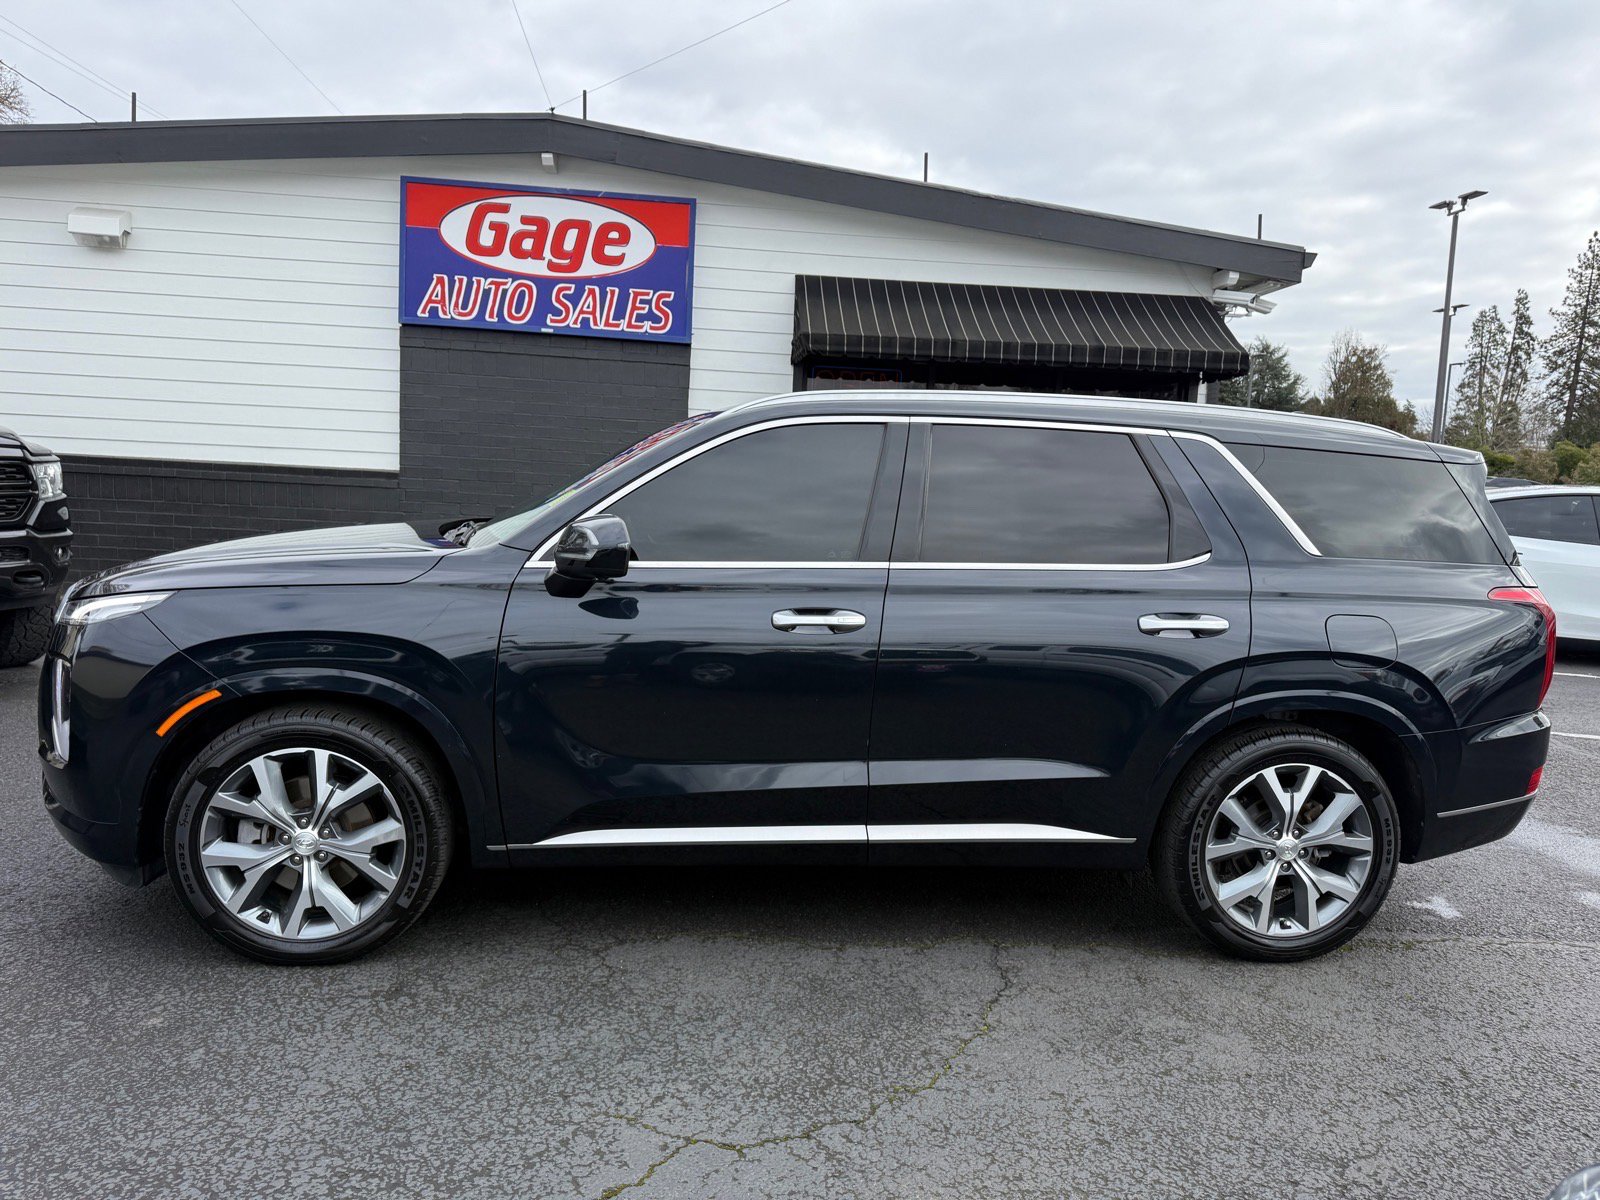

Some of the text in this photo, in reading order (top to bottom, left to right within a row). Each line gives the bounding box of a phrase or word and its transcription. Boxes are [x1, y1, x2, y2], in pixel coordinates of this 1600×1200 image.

[465, 202, 631, 274] Gage
[417, 274, 675, 333] AUTO SALES
